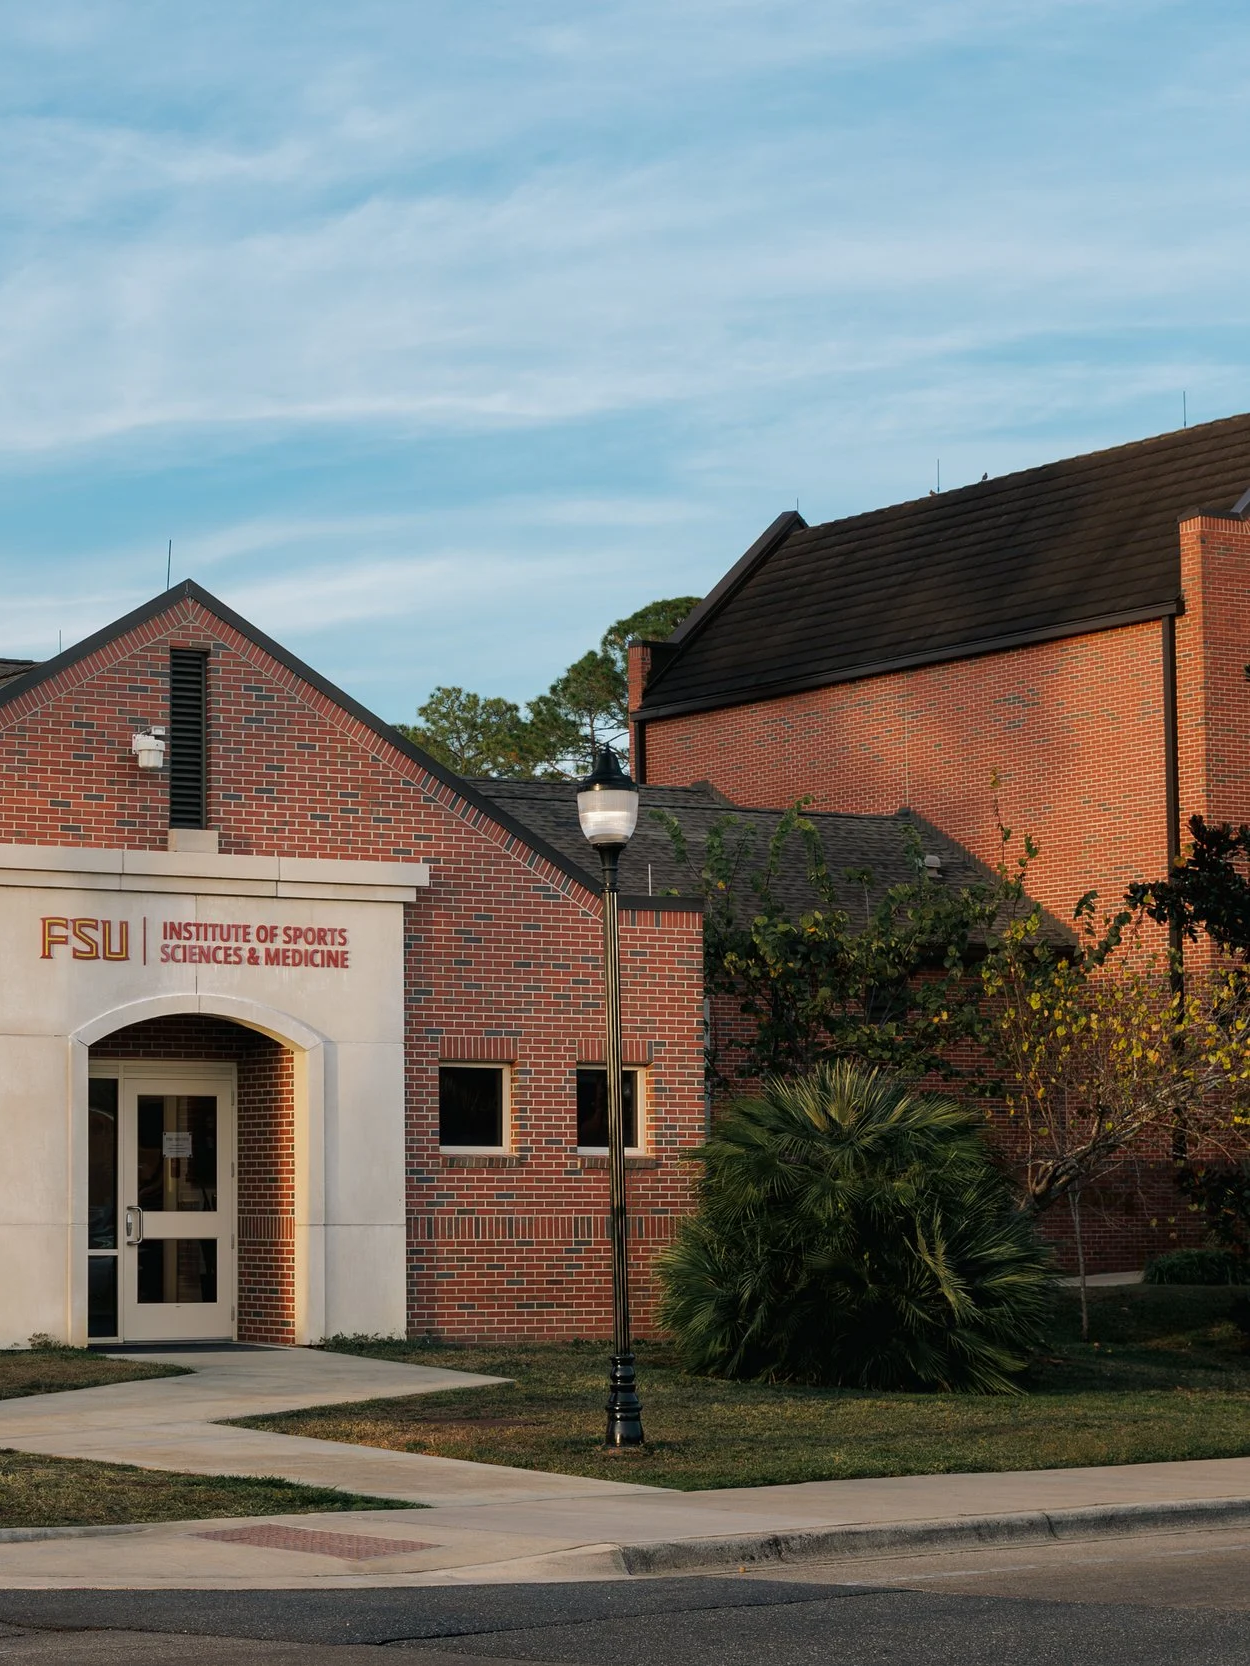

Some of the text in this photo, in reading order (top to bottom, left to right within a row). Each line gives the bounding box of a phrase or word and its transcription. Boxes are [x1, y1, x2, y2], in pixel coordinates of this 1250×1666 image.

[40, 916, 130, 962] FSU
[163, 921, 348, 946] INSTITUTE OF SPORTS
[160, 943, 350, 969] SCIENCES & MEDICINE
